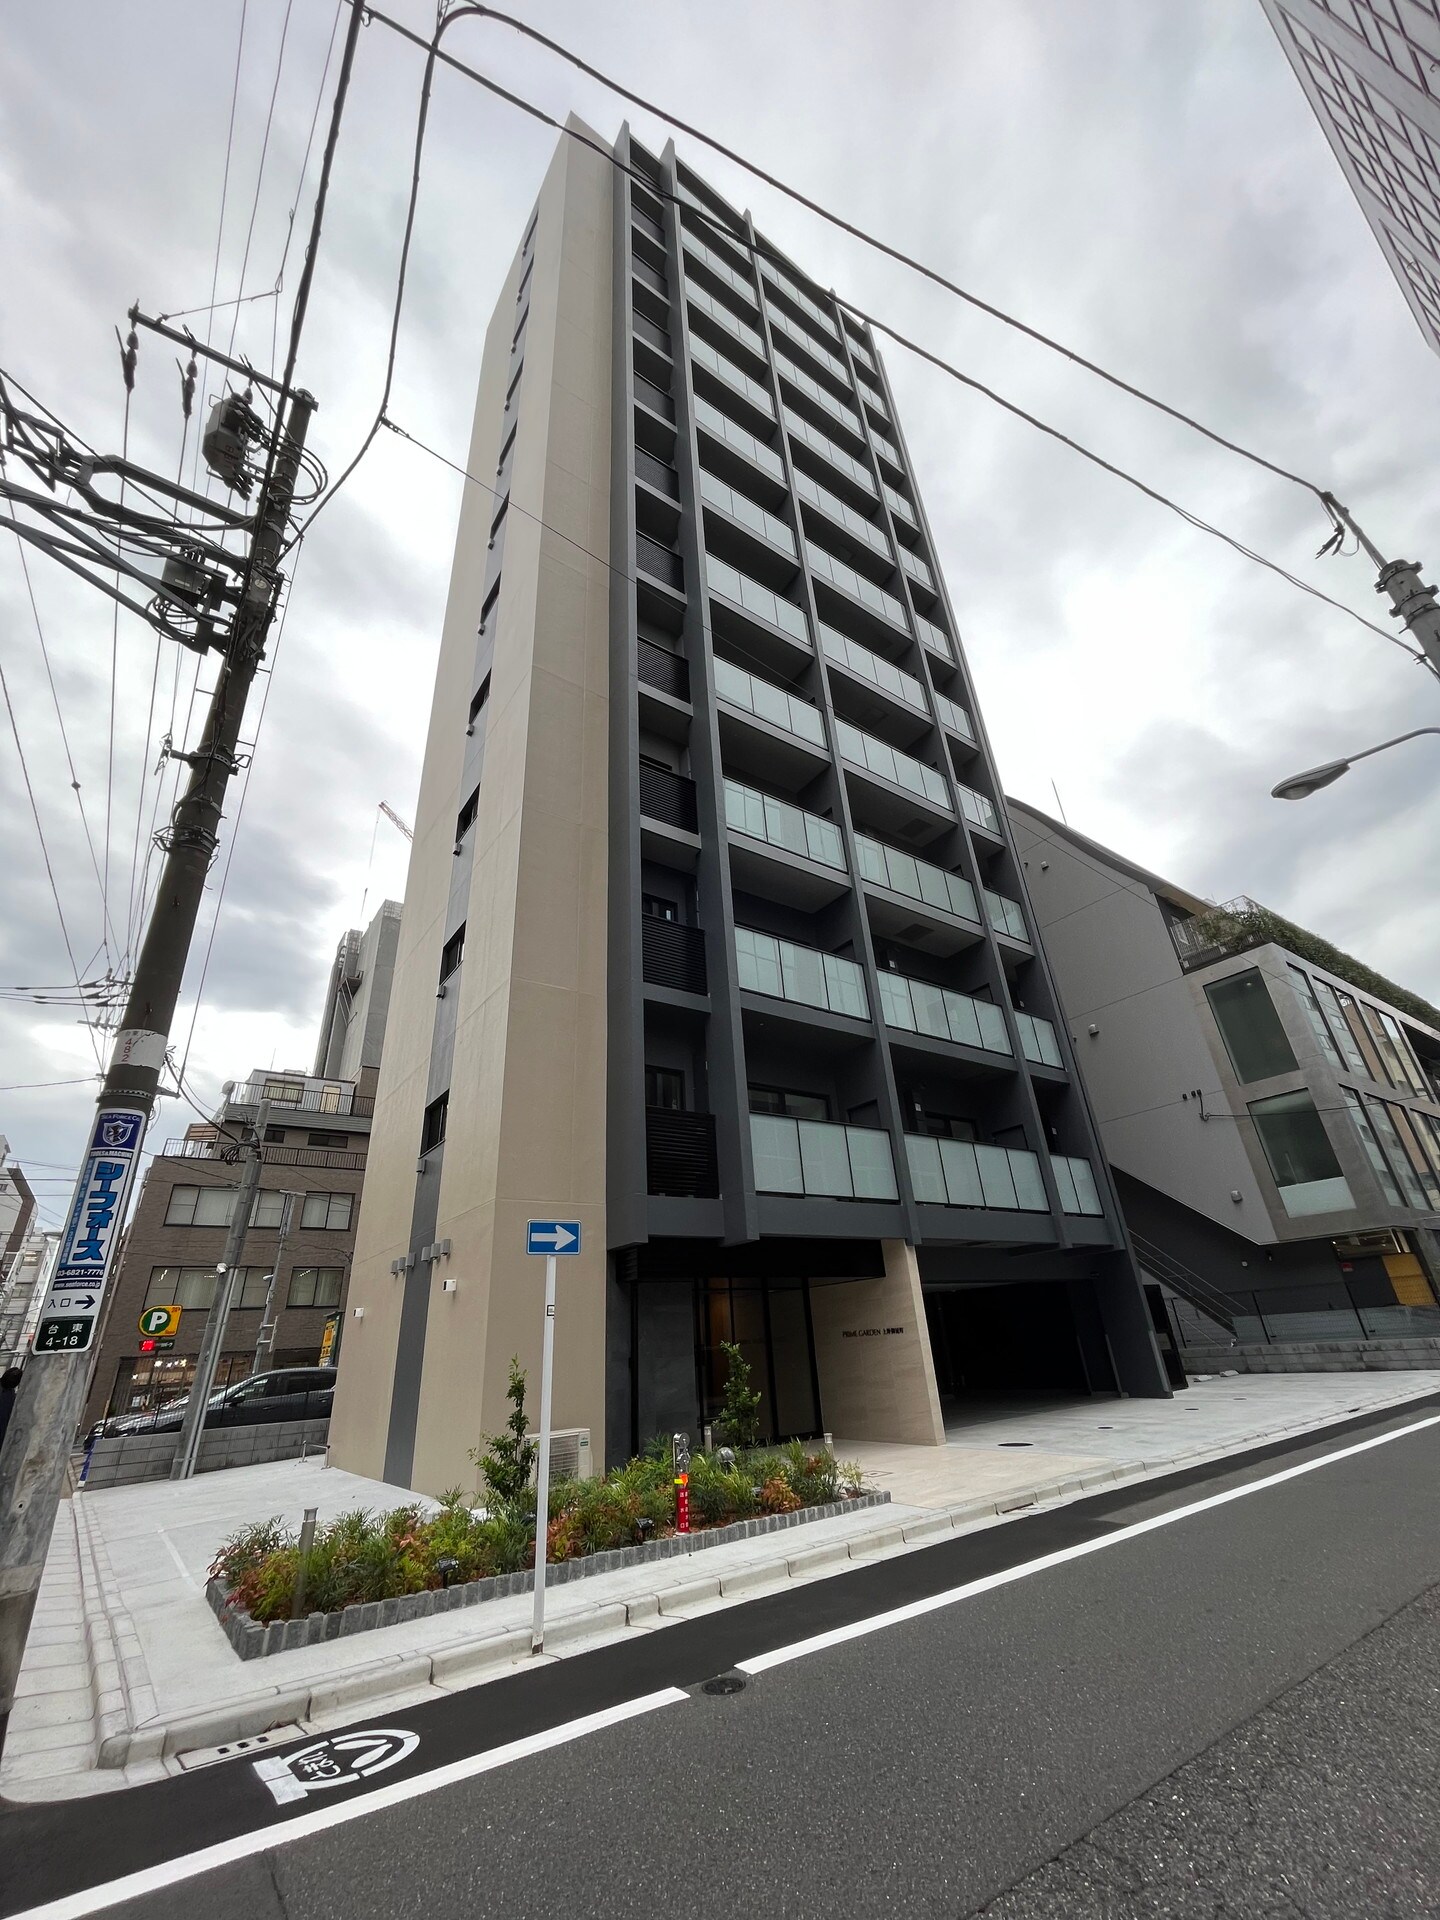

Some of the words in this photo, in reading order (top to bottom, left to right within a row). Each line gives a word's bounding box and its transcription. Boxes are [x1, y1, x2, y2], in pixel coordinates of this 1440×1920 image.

[121, 1038, 132, 1062] 482
[72, 1161, 125, 1261] シーフォース
[48, 1298, 72, 1309] 入口
[148, 1311, 168, 1331] P
[48, 1323, 84, 1335] 台東
[858, 1328, 881, 1337] GARDEN
[45, 1335, 79, 1347] 4-18
